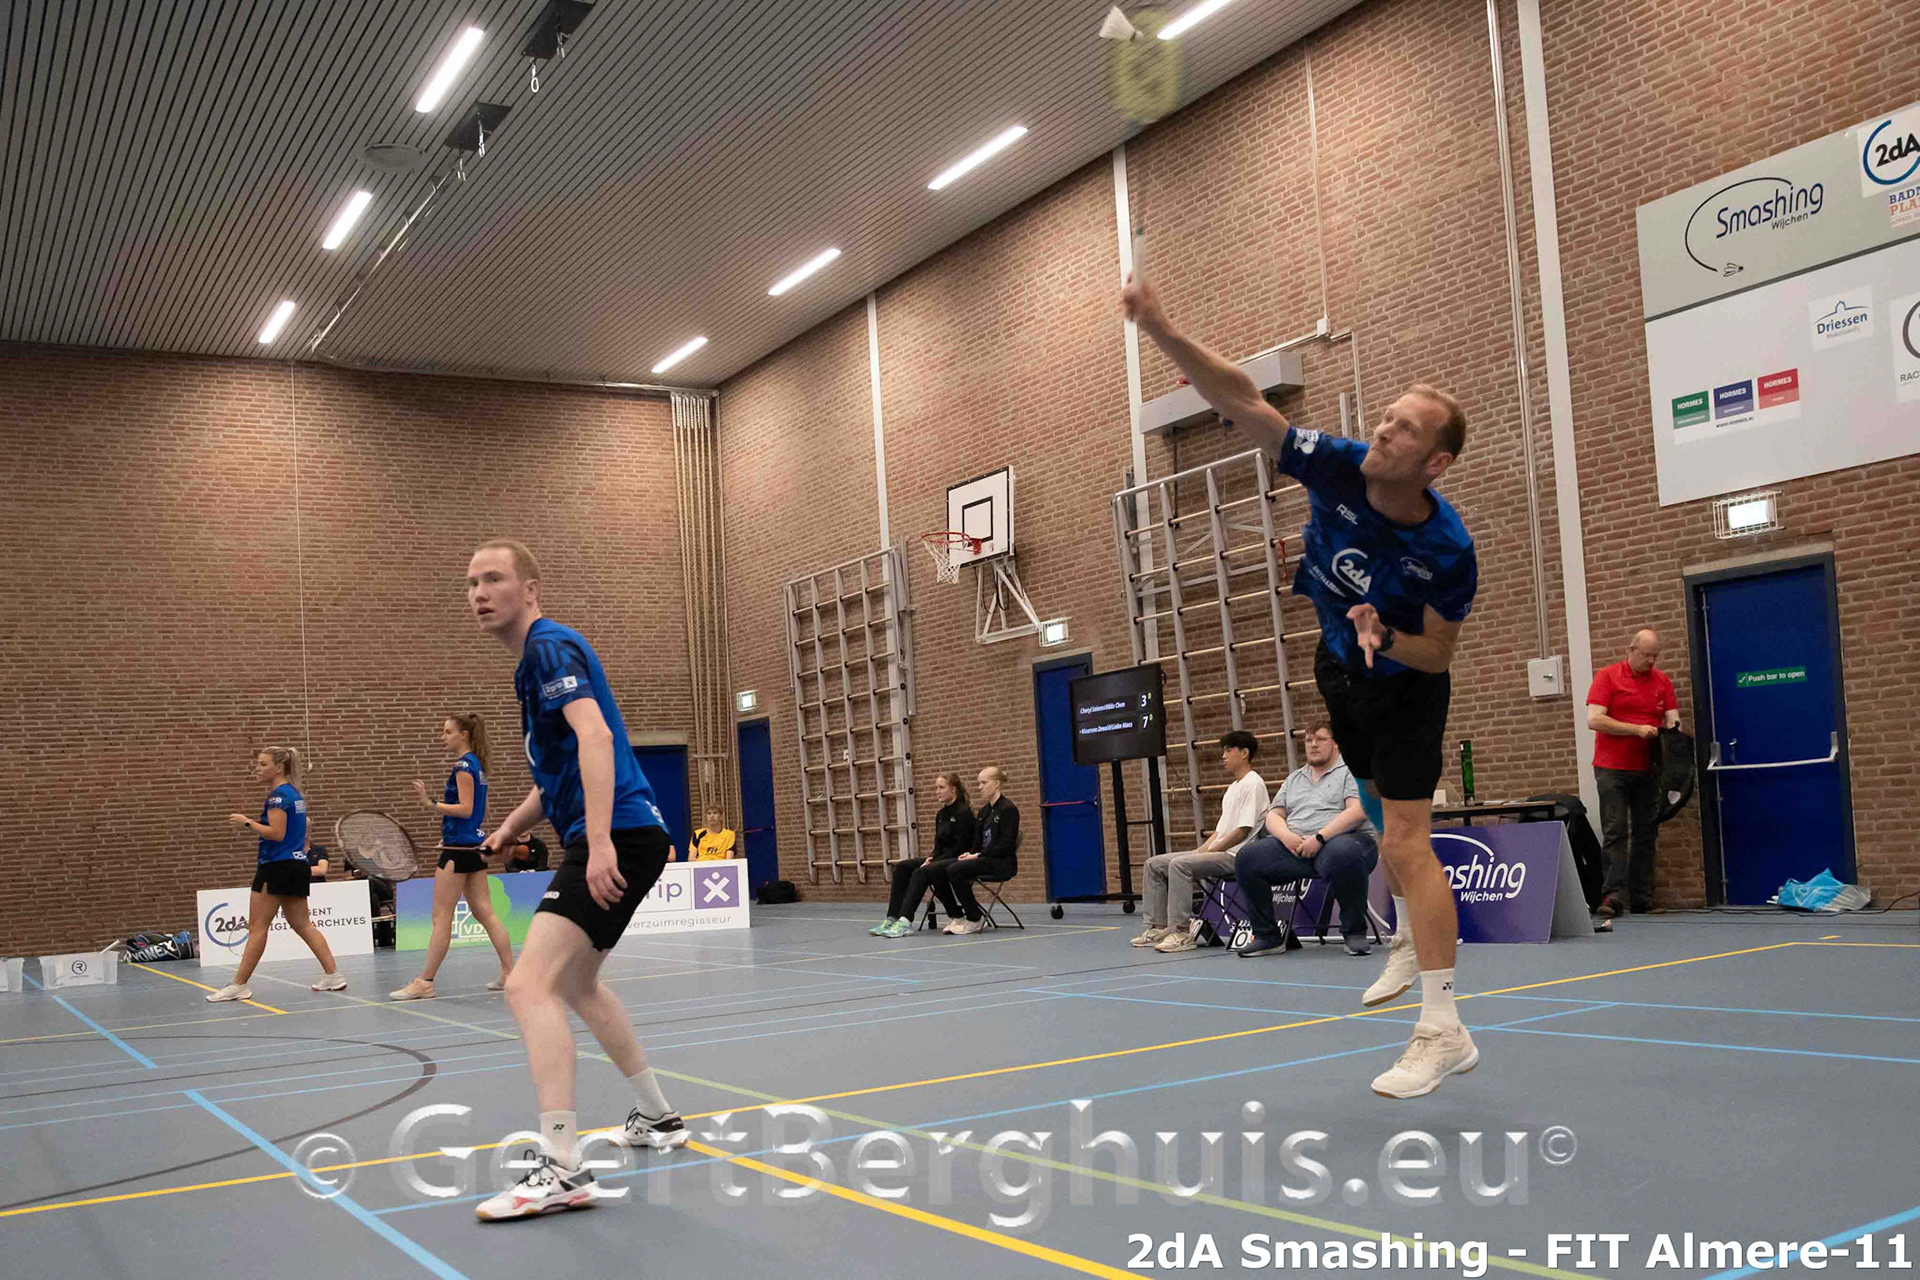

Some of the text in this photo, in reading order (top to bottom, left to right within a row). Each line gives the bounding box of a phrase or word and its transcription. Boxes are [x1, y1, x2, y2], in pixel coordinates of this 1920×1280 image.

[1716, 182, 1824, 239] Smashing
[1771, 212, 1809, 231] Wijchen
[1817, 312, 1868, 335] Driessen
[1763, 376, 1793, 389] HORMES
[1719, 387, 1747, 400] HORMES
[1677, 398, 1703, 410] HORMES
[1336, 503, 1358, 525] RSL
[1339, 559, 1372, 593] 2dA
[1748, 674, 1765, 682] Push
[1766, 673, 1778, 681] bar
[1787, 670, 1806, 679] open
[1141, 694, 1147, 707] 3
[1142, 715, 1149, 728] 7
[1460, 890, 1504, 904] Wijchen
[214, 915, 249, 933] 2dA
[131, 940, 176, 962] YONEX
